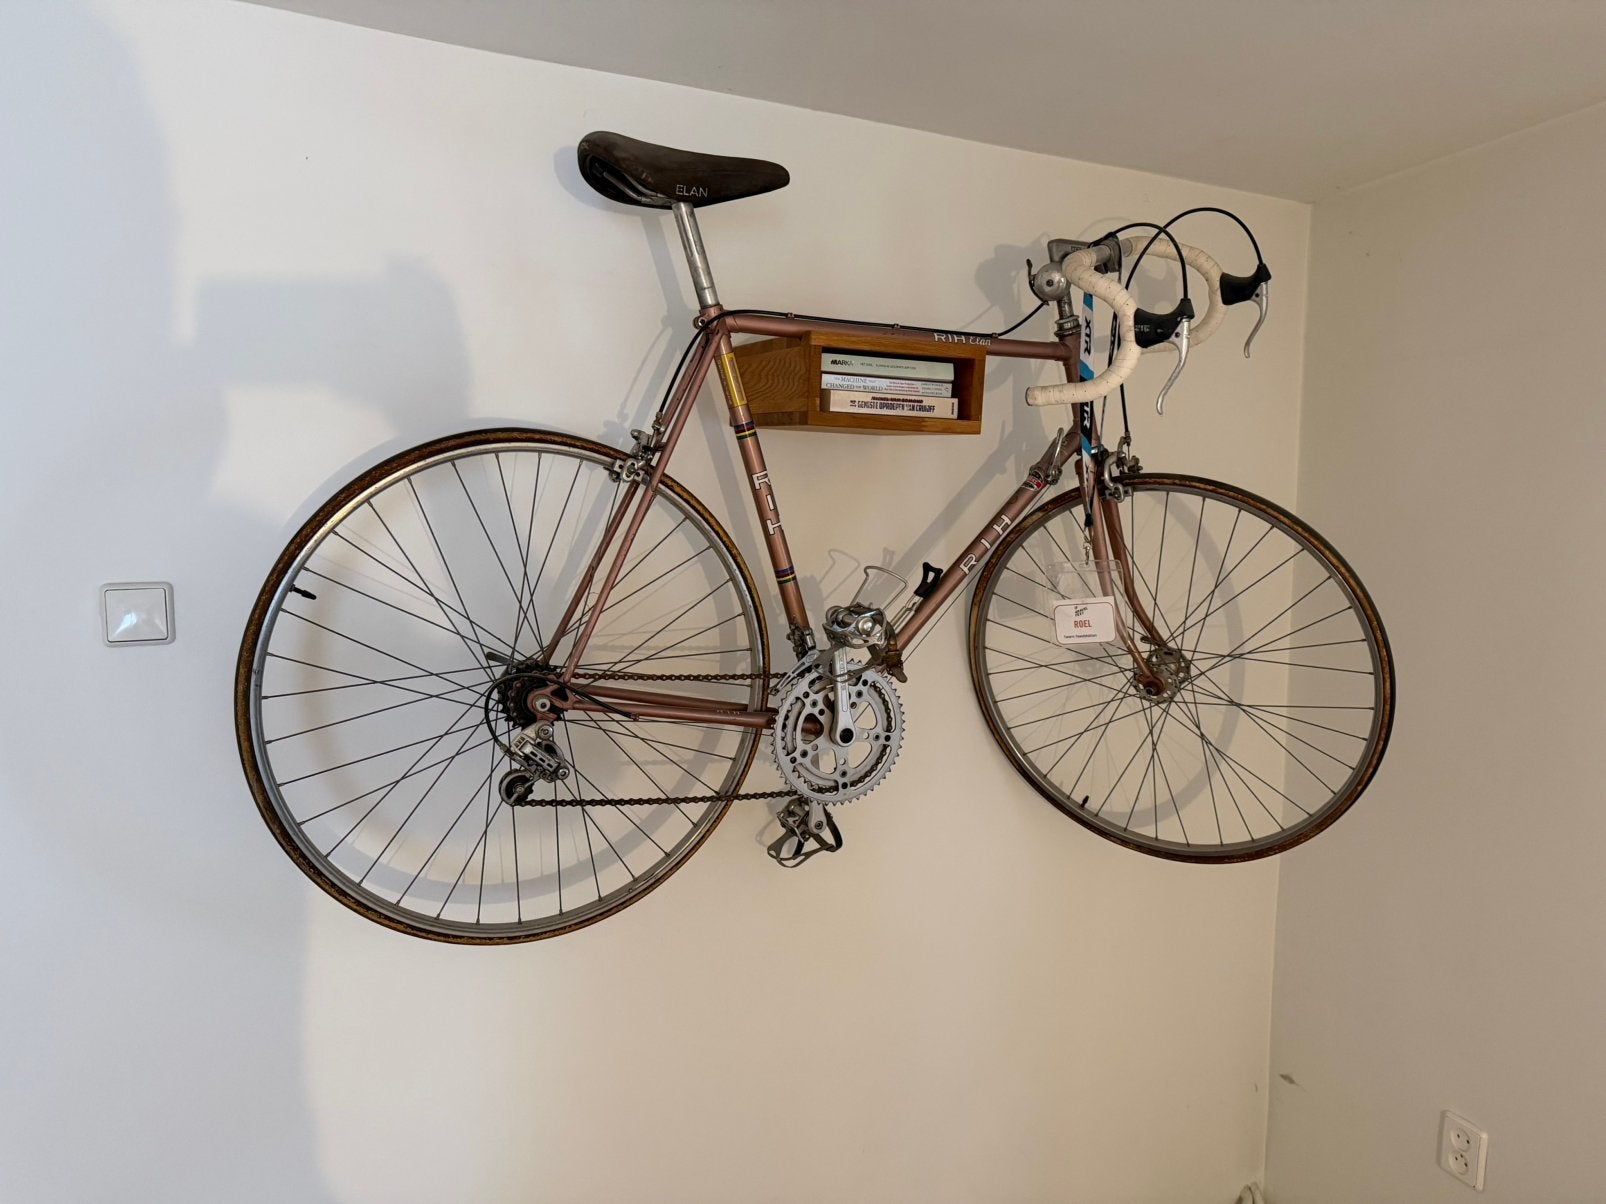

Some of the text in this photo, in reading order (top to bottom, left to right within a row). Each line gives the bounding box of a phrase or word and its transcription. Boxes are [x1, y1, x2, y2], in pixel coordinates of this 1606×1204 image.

[675, 184, 708, 198] ELAN
[933, 332, 966, 344] RIH
[1083, 316, 1092, 357] XTR
[840, 376, 868, 384] MACHINE
[826, 382, 855, 390] CHANGED
[862, 384, 884, 392] WORLD
[1083, 401, 1092, 430] TR
[959, 514, 1012, 575] RIH
[1073, 619, 1093, 628] ROEL
